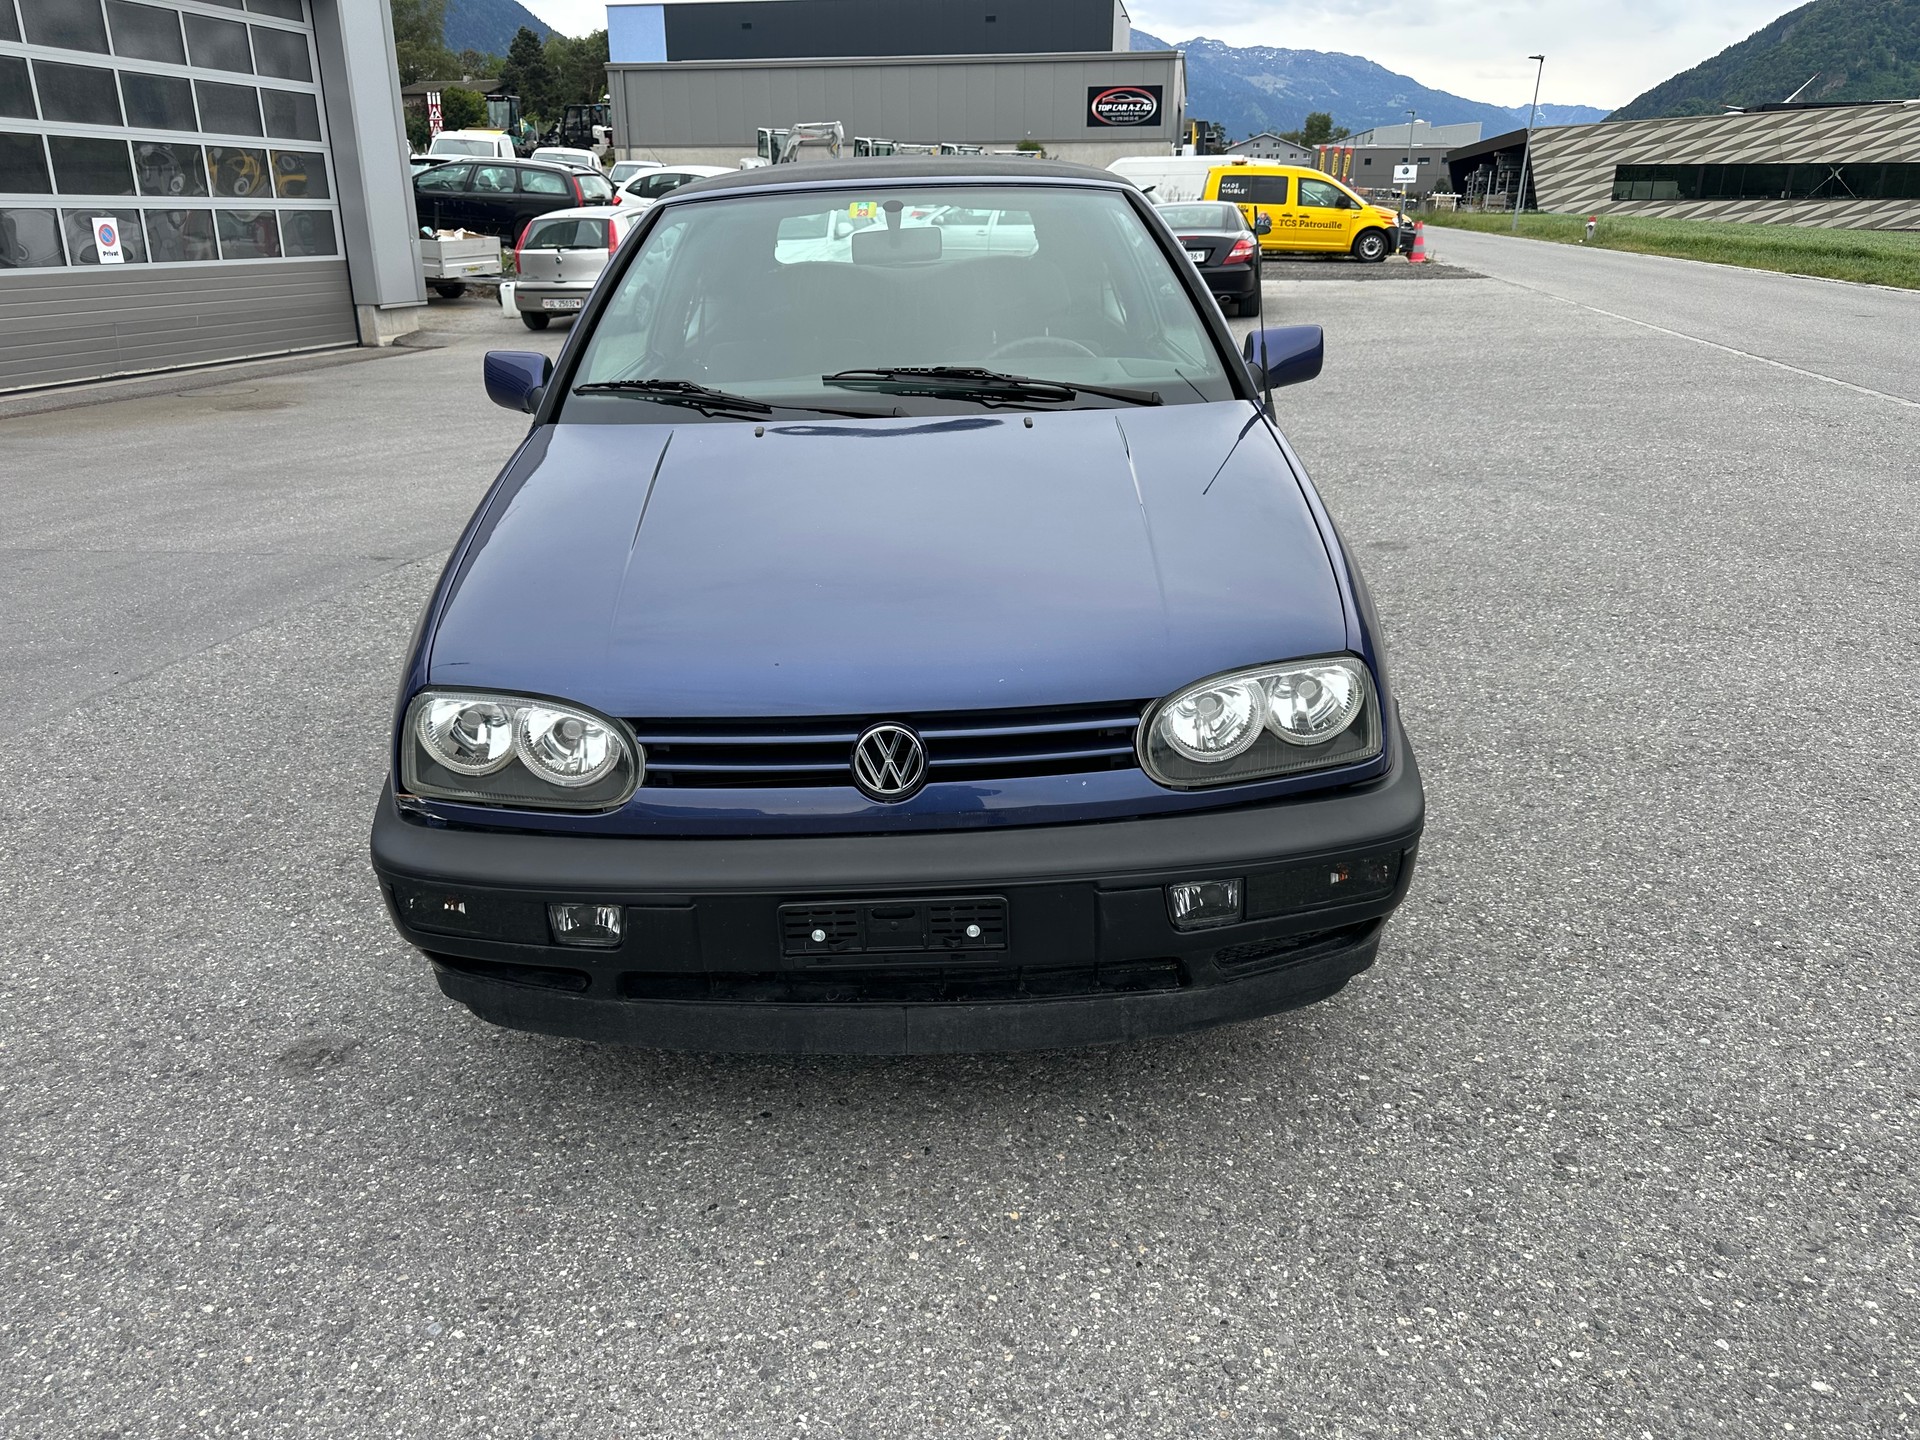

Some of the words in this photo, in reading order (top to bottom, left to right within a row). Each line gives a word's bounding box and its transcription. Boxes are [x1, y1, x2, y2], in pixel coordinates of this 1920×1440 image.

[1128, 103, 1141, 111] A-Z
[857, 208, 869, 217] 23
[1279, 219, 1297, 227] TCS
[1299, 219, 1343, 229] Patrouille
